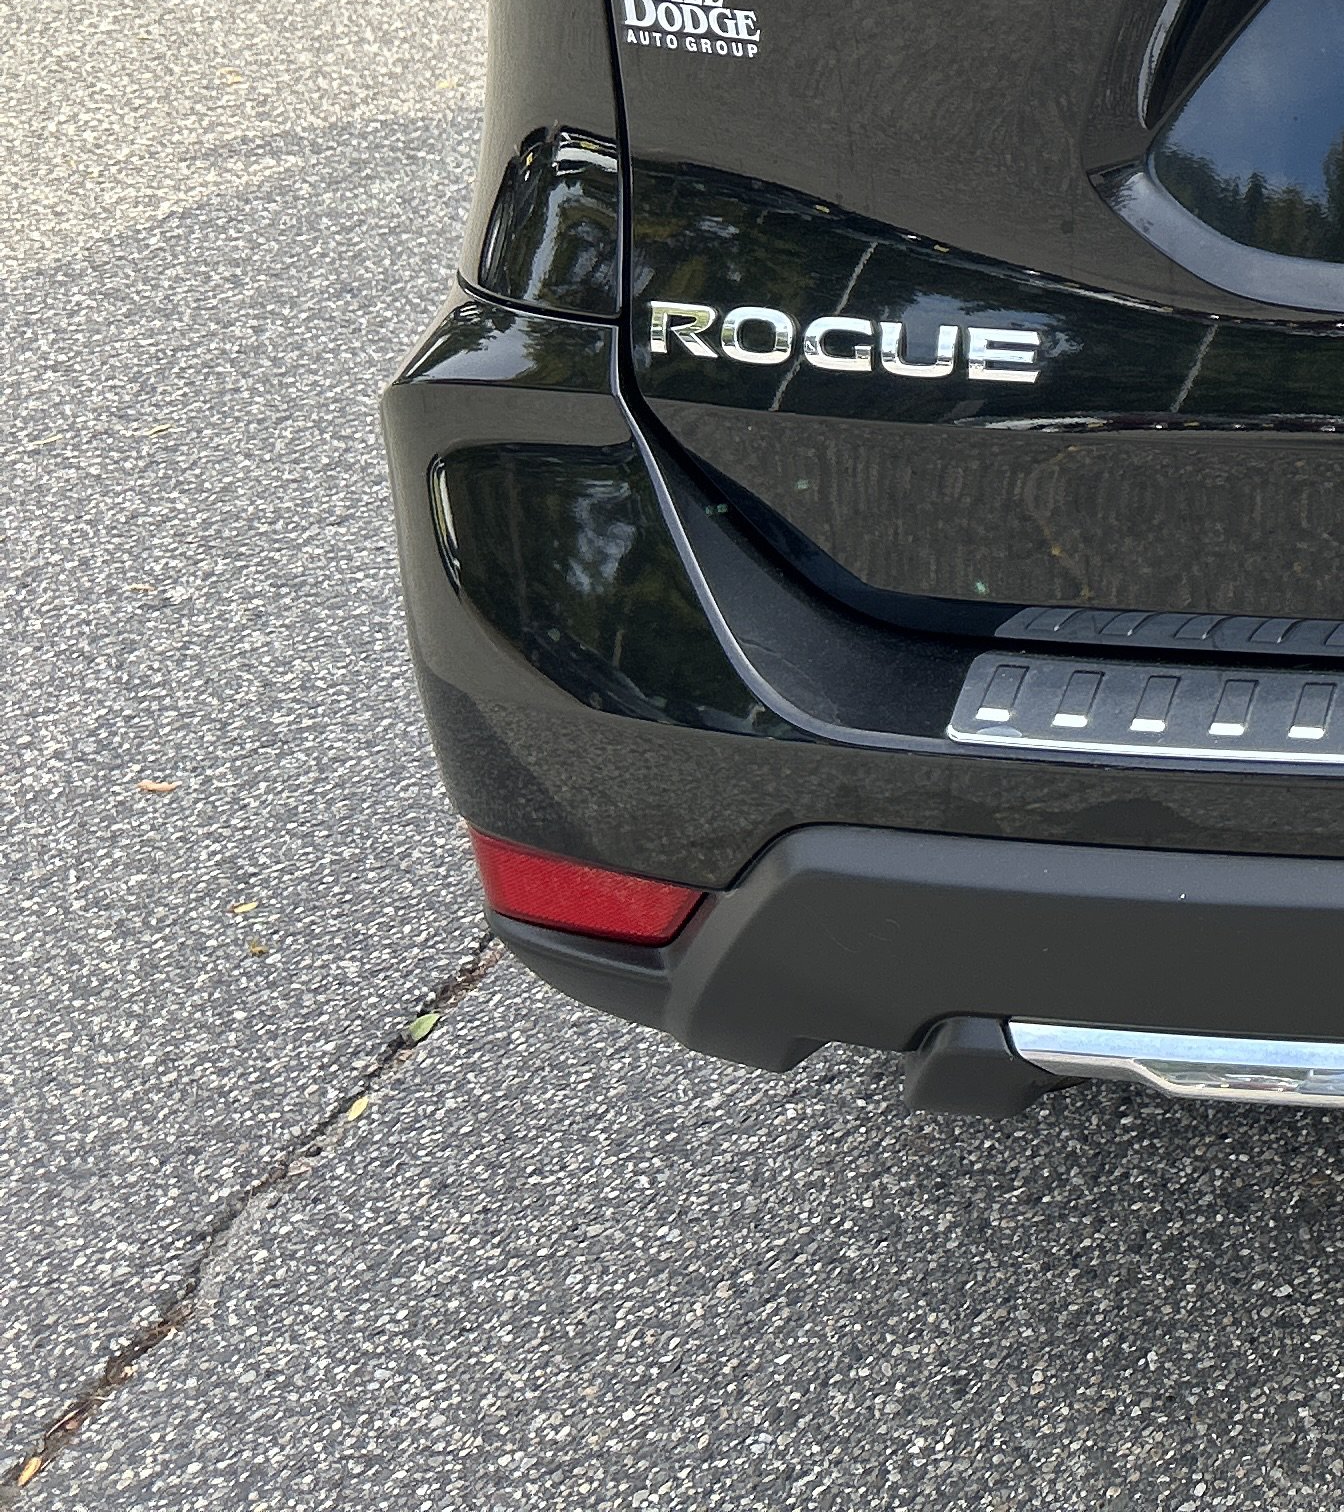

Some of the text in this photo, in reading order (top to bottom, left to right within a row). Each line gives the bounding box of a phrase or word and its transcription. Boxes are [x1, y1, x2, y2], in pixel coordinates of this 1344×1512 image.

[626, 29, 758, 58] AUTO GROUP
[648, 299, 1041, 384] ROGUE
